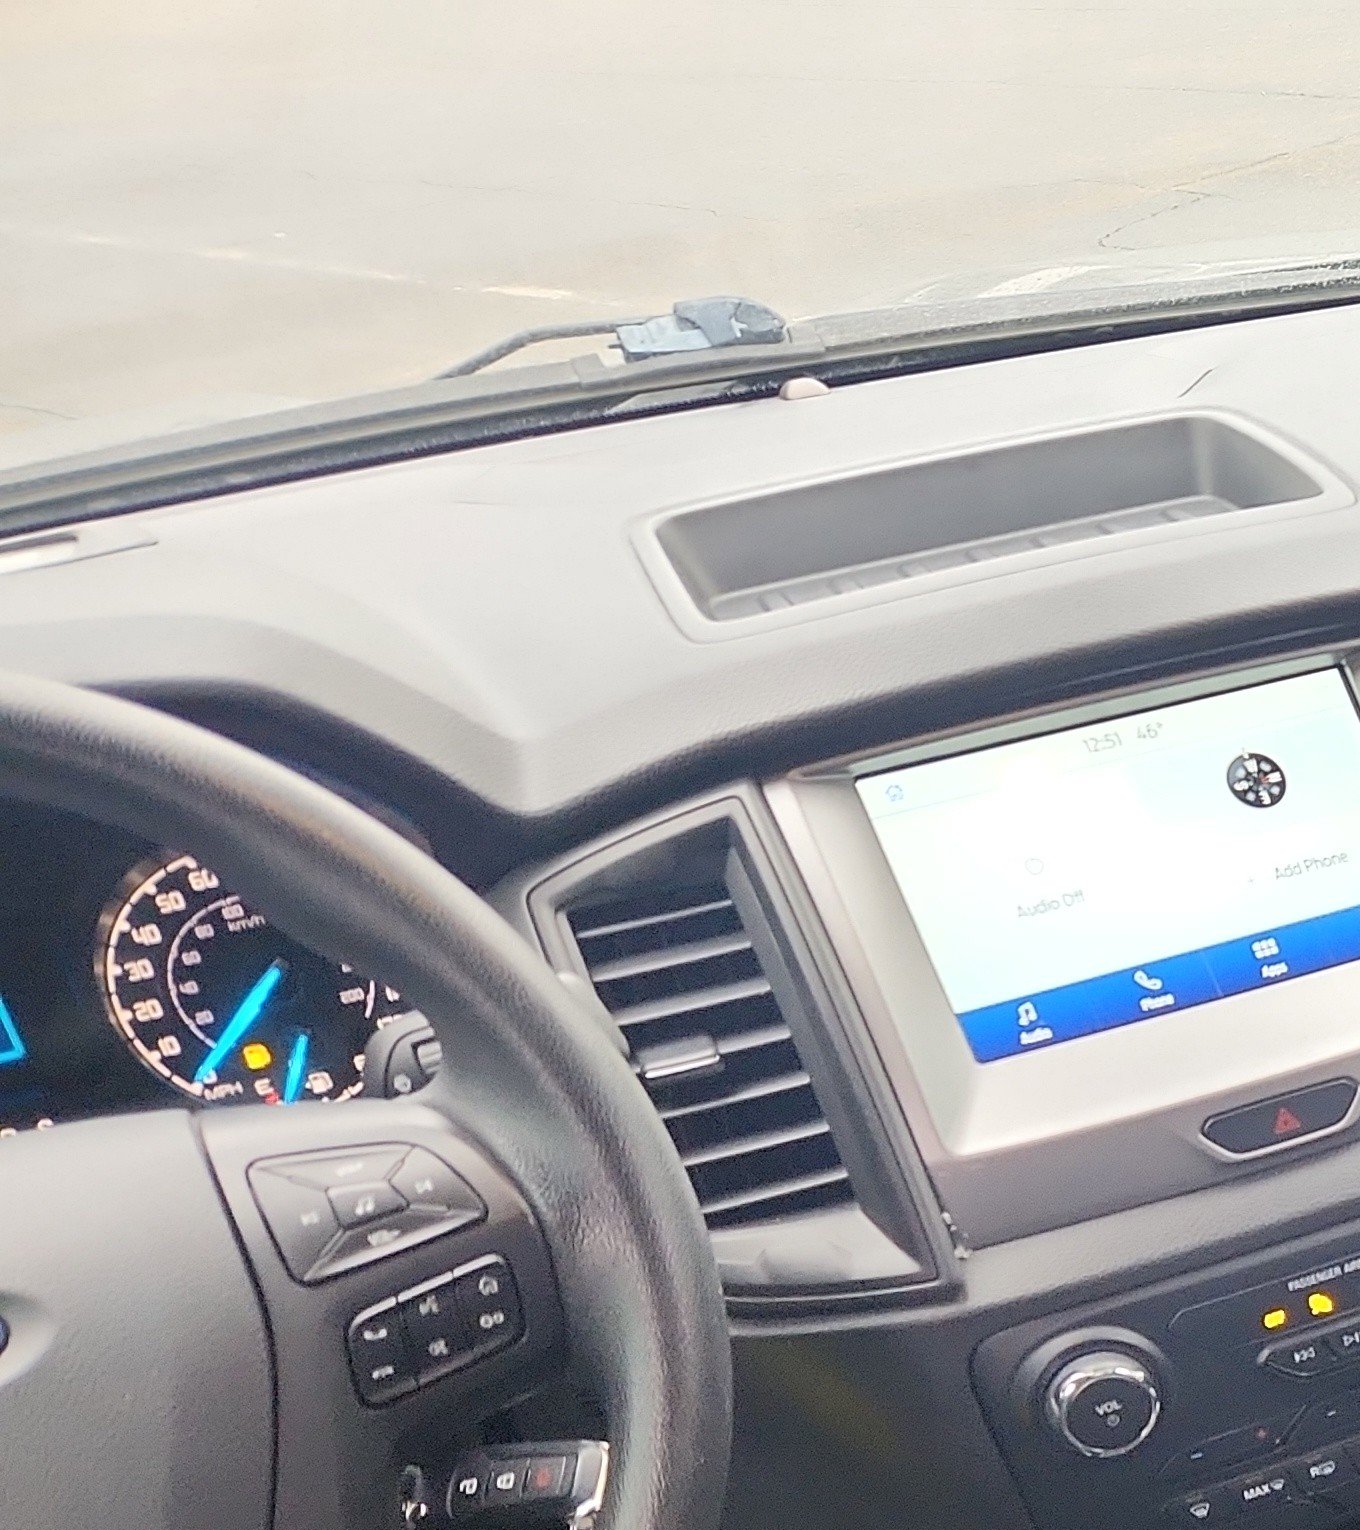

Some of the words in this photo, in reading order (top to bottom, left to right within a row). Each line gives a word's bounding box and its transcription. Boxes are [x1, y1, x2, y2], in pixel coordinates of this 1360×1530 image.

[1275, 862, 1302, 880] Add
[1303, 853, 1348, 872] Phone
[155, 890, 186, 914] 50
[131, 923, 162, 946] 40
[124, 958, 154, 982] 30
[132, 998, 164, 1022] 20
[204, 1081, 243, 1100] MPH
[1095, 1399, 1122, 1416] VOL
[1243, 1483, 1271, 1501] MAX
